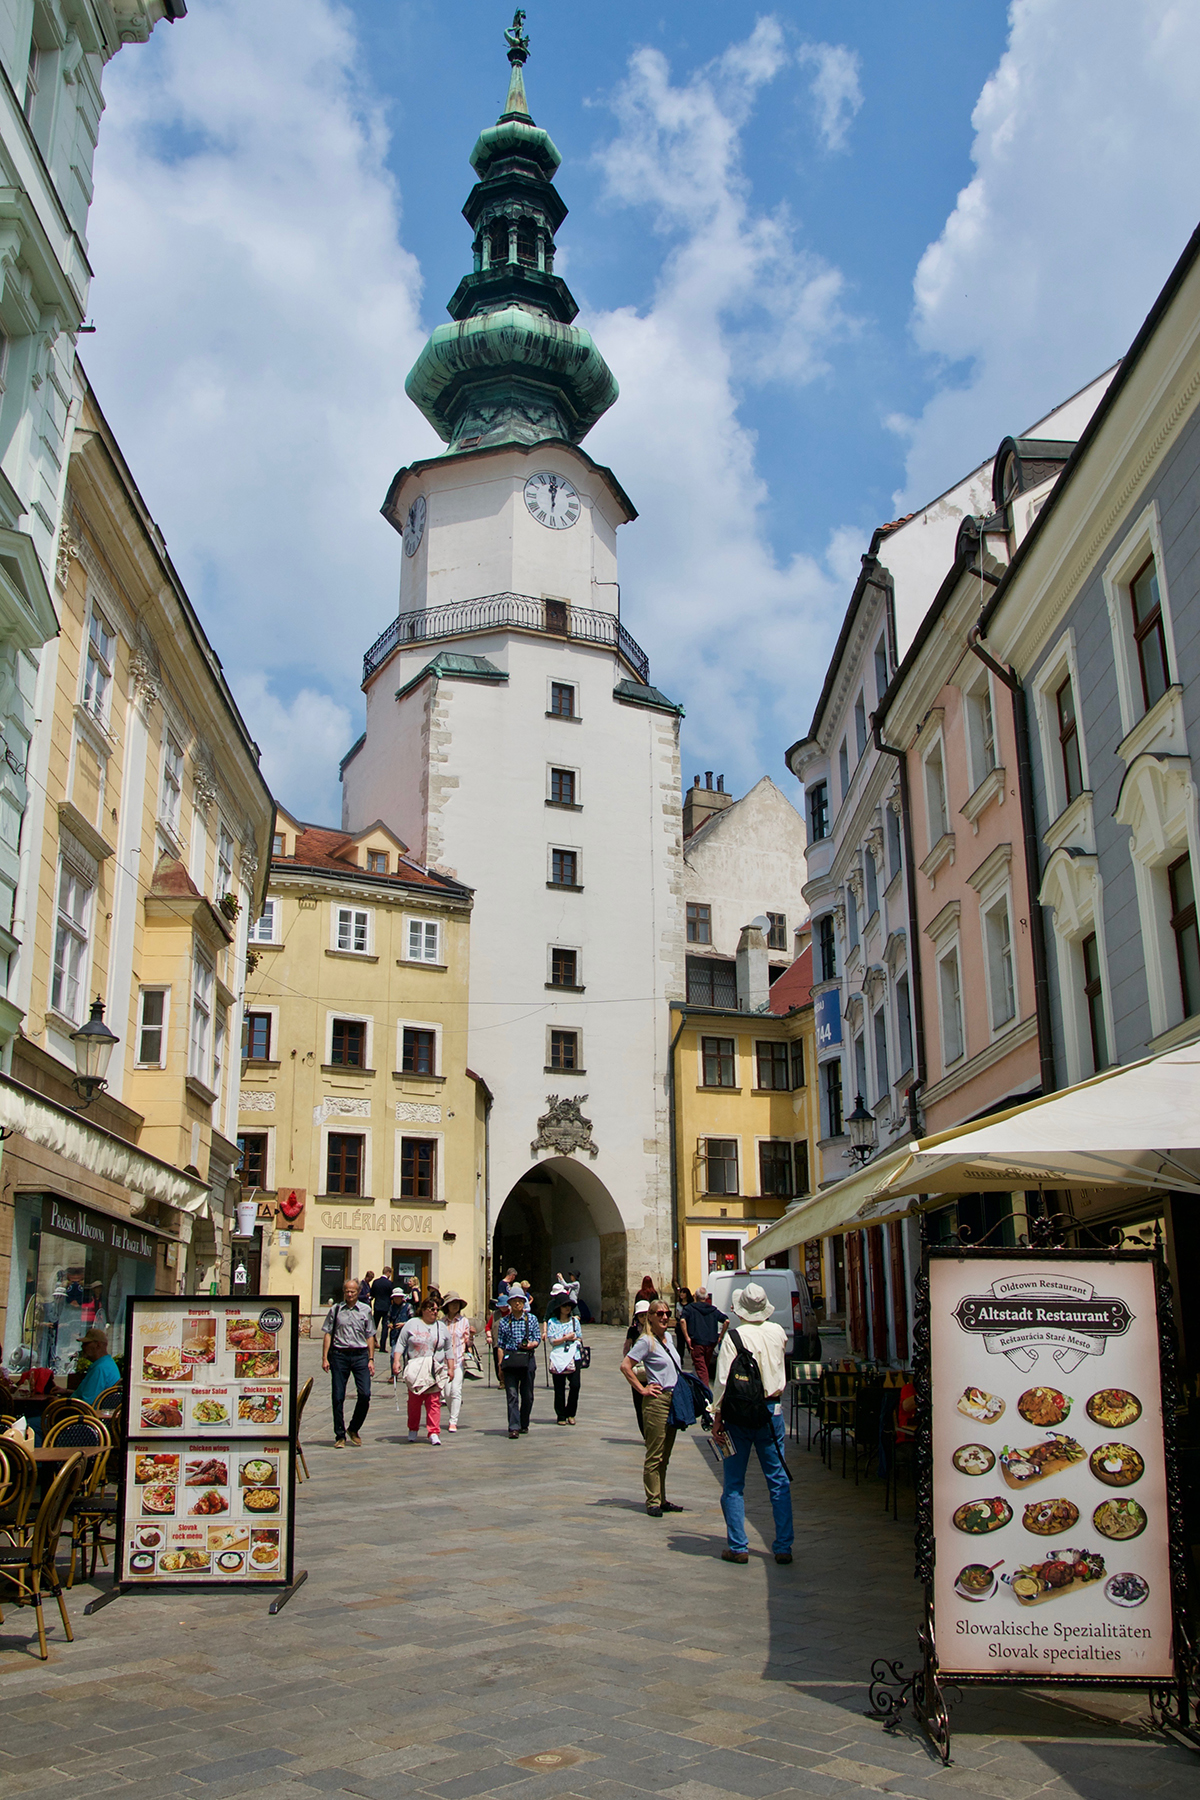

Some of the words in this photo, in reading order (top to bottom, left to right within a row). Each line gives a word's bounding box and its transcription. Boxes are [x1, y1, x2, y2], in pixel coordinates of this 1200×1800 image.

[321, 1208, 387, 1231] GALÉRIA
[390, 1214, 432, 1233] NOVA
[122, 1228, 140, 1254] PRAGUE
[1000, 1280, 1038, 1294] Oldtown
[1039, 1279, 1087, 1296] Restaurant
[978, 1306, 1033, 1322] Altstadt
[1036, 1307, 1110, 1322] Restaurant
[999, 1332, 1044, 1347] Reštaurácia
[1045, 1332, 1066, 1342] Staré
[1067, 1335, 1091, 1349] Mesto
[150, 1387, 162, 1395] BBQ
[189, 1444, 212, 1452] Chicken
[212, 1444, 230, 1453] wings
[955, 1619, 1049, 1637] Slowakische
[1053, 1622, 1152, 1642] Spezialitäten
[988, 1642, 1039, 1659] Slovak
[1043, 1644, 1121, 1664] specialties
